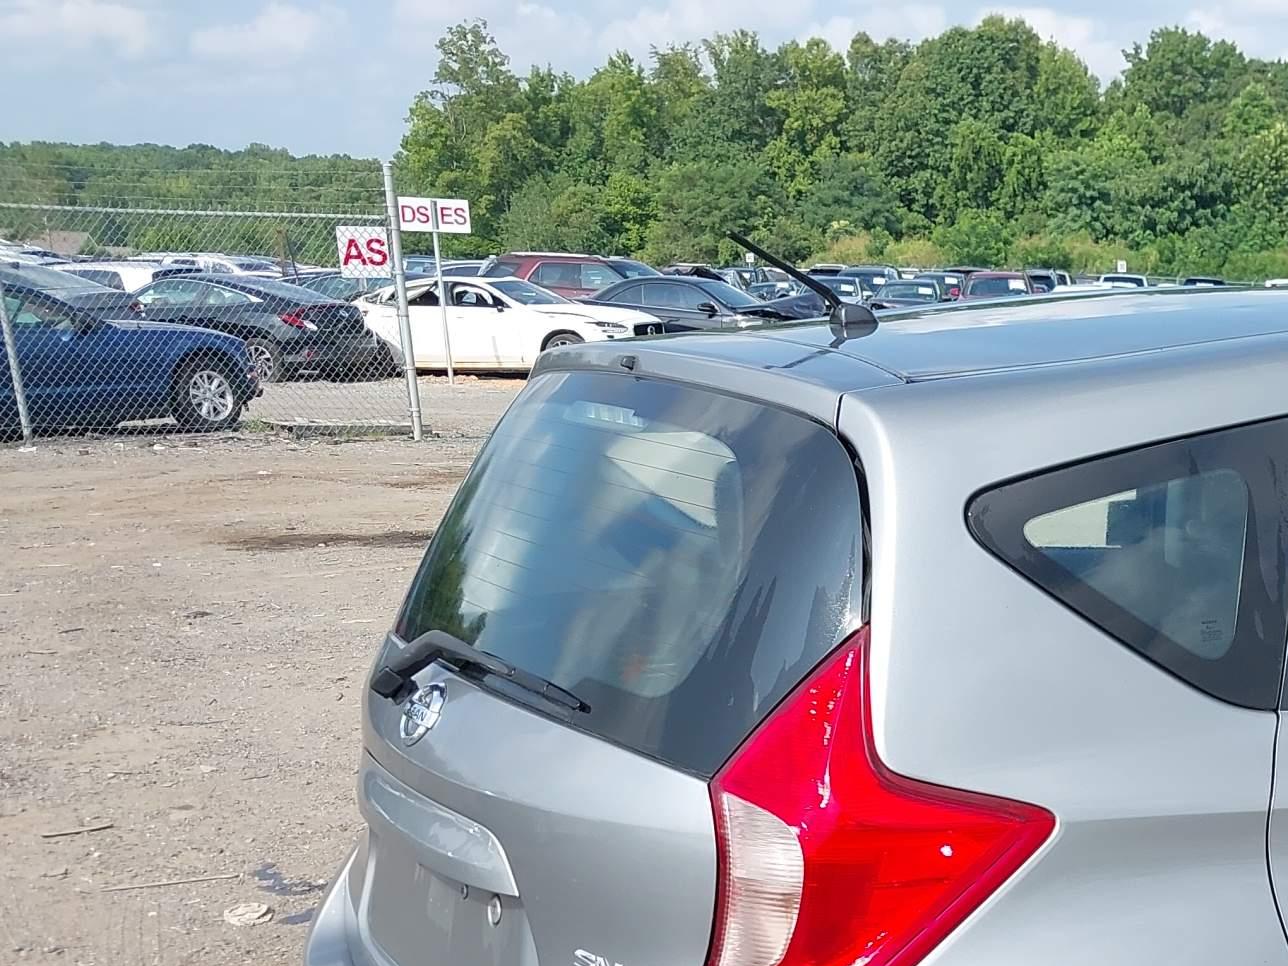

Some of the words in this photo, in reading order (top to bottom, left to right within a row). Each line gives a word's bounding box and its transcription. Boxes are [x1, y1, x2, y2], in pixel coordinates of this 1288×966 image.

[400, 205, 430, 224] DS
[440, 207, 467, 225] ES
[343, 238, 388, 266] AS
